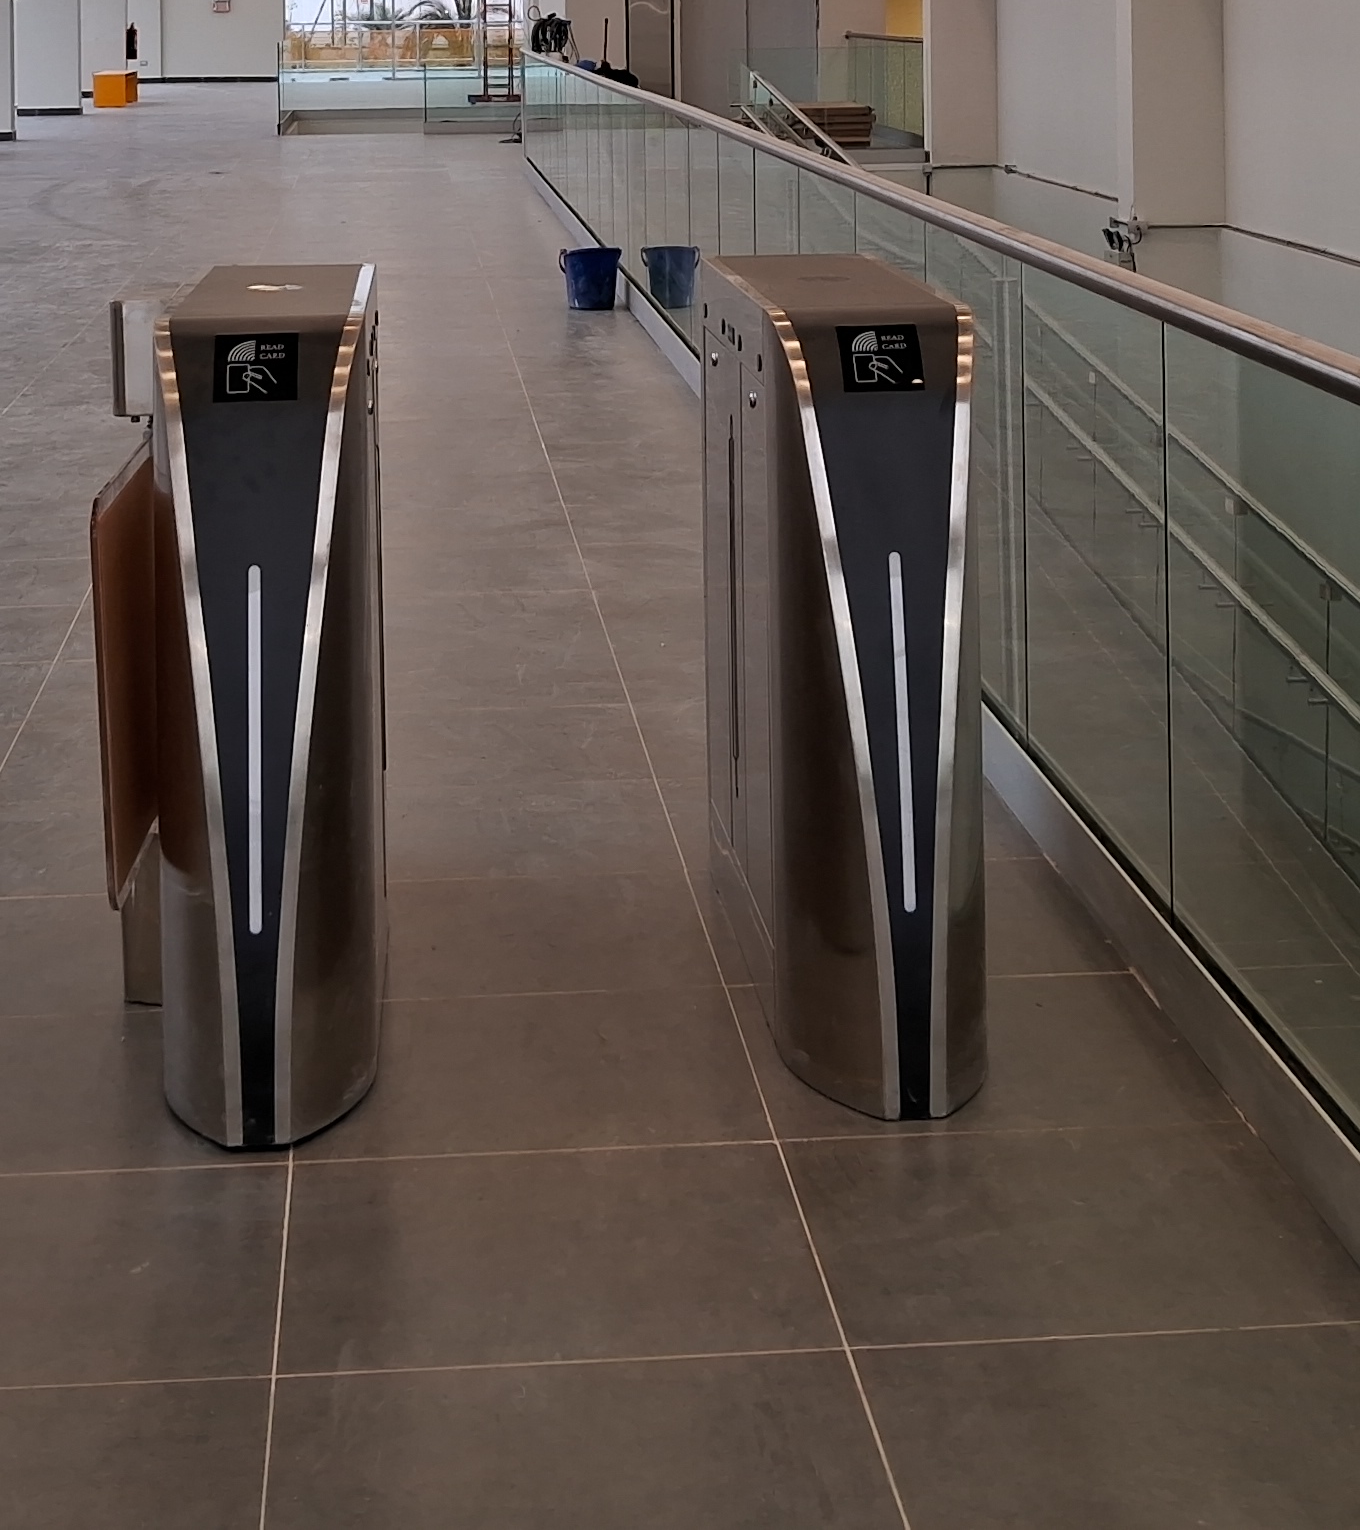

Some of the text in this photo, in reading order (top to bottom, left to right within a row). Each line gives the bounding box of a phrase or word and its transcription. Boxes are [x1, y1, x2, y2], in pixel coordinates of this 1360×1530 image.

[260, 343, 285, 351] READ
[881, 342, 907, 350] CARD
[259, 352, 286, 360] CARD
